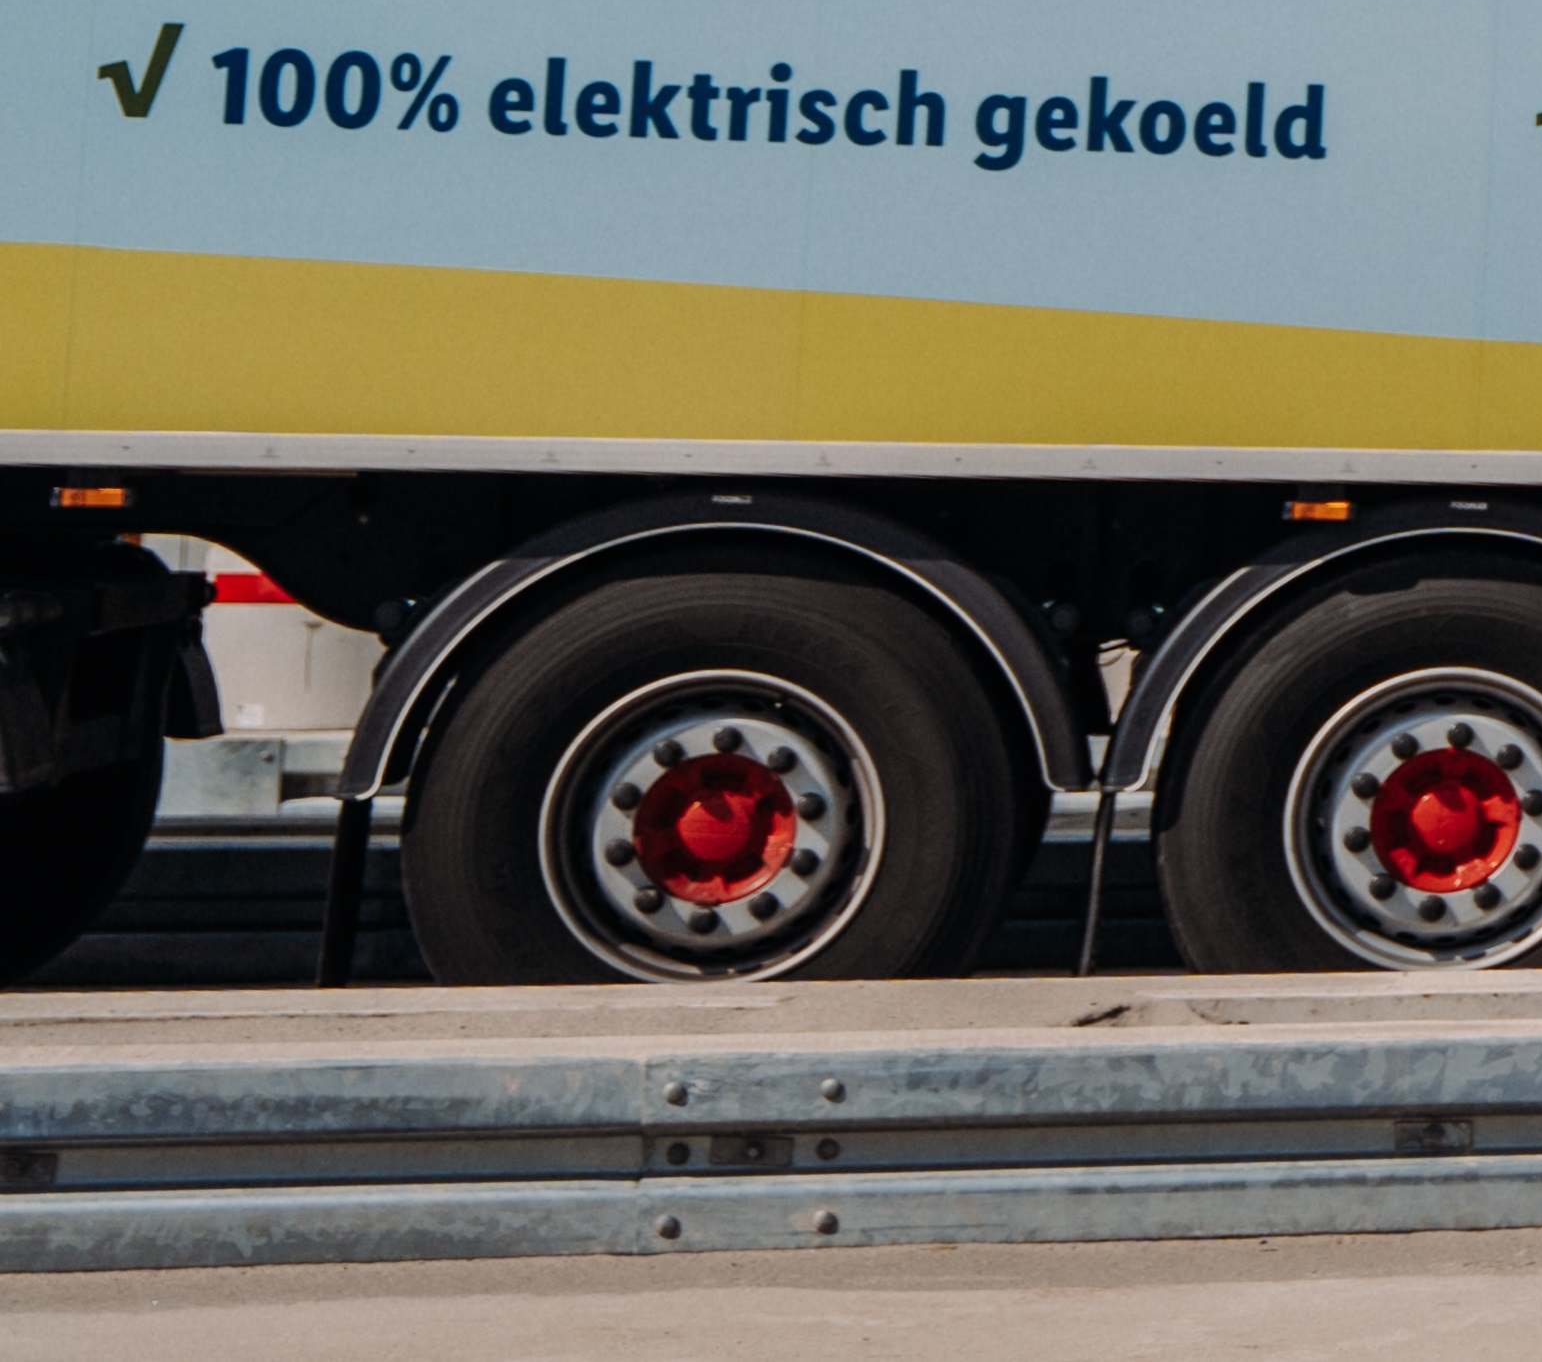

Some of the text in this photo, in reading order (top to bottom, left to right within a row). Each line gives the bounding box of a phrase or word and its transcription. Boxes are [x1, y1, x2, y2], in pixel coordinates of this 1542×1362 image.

[211, 45, 1328, 173] 100% elektrisch gekoeld
